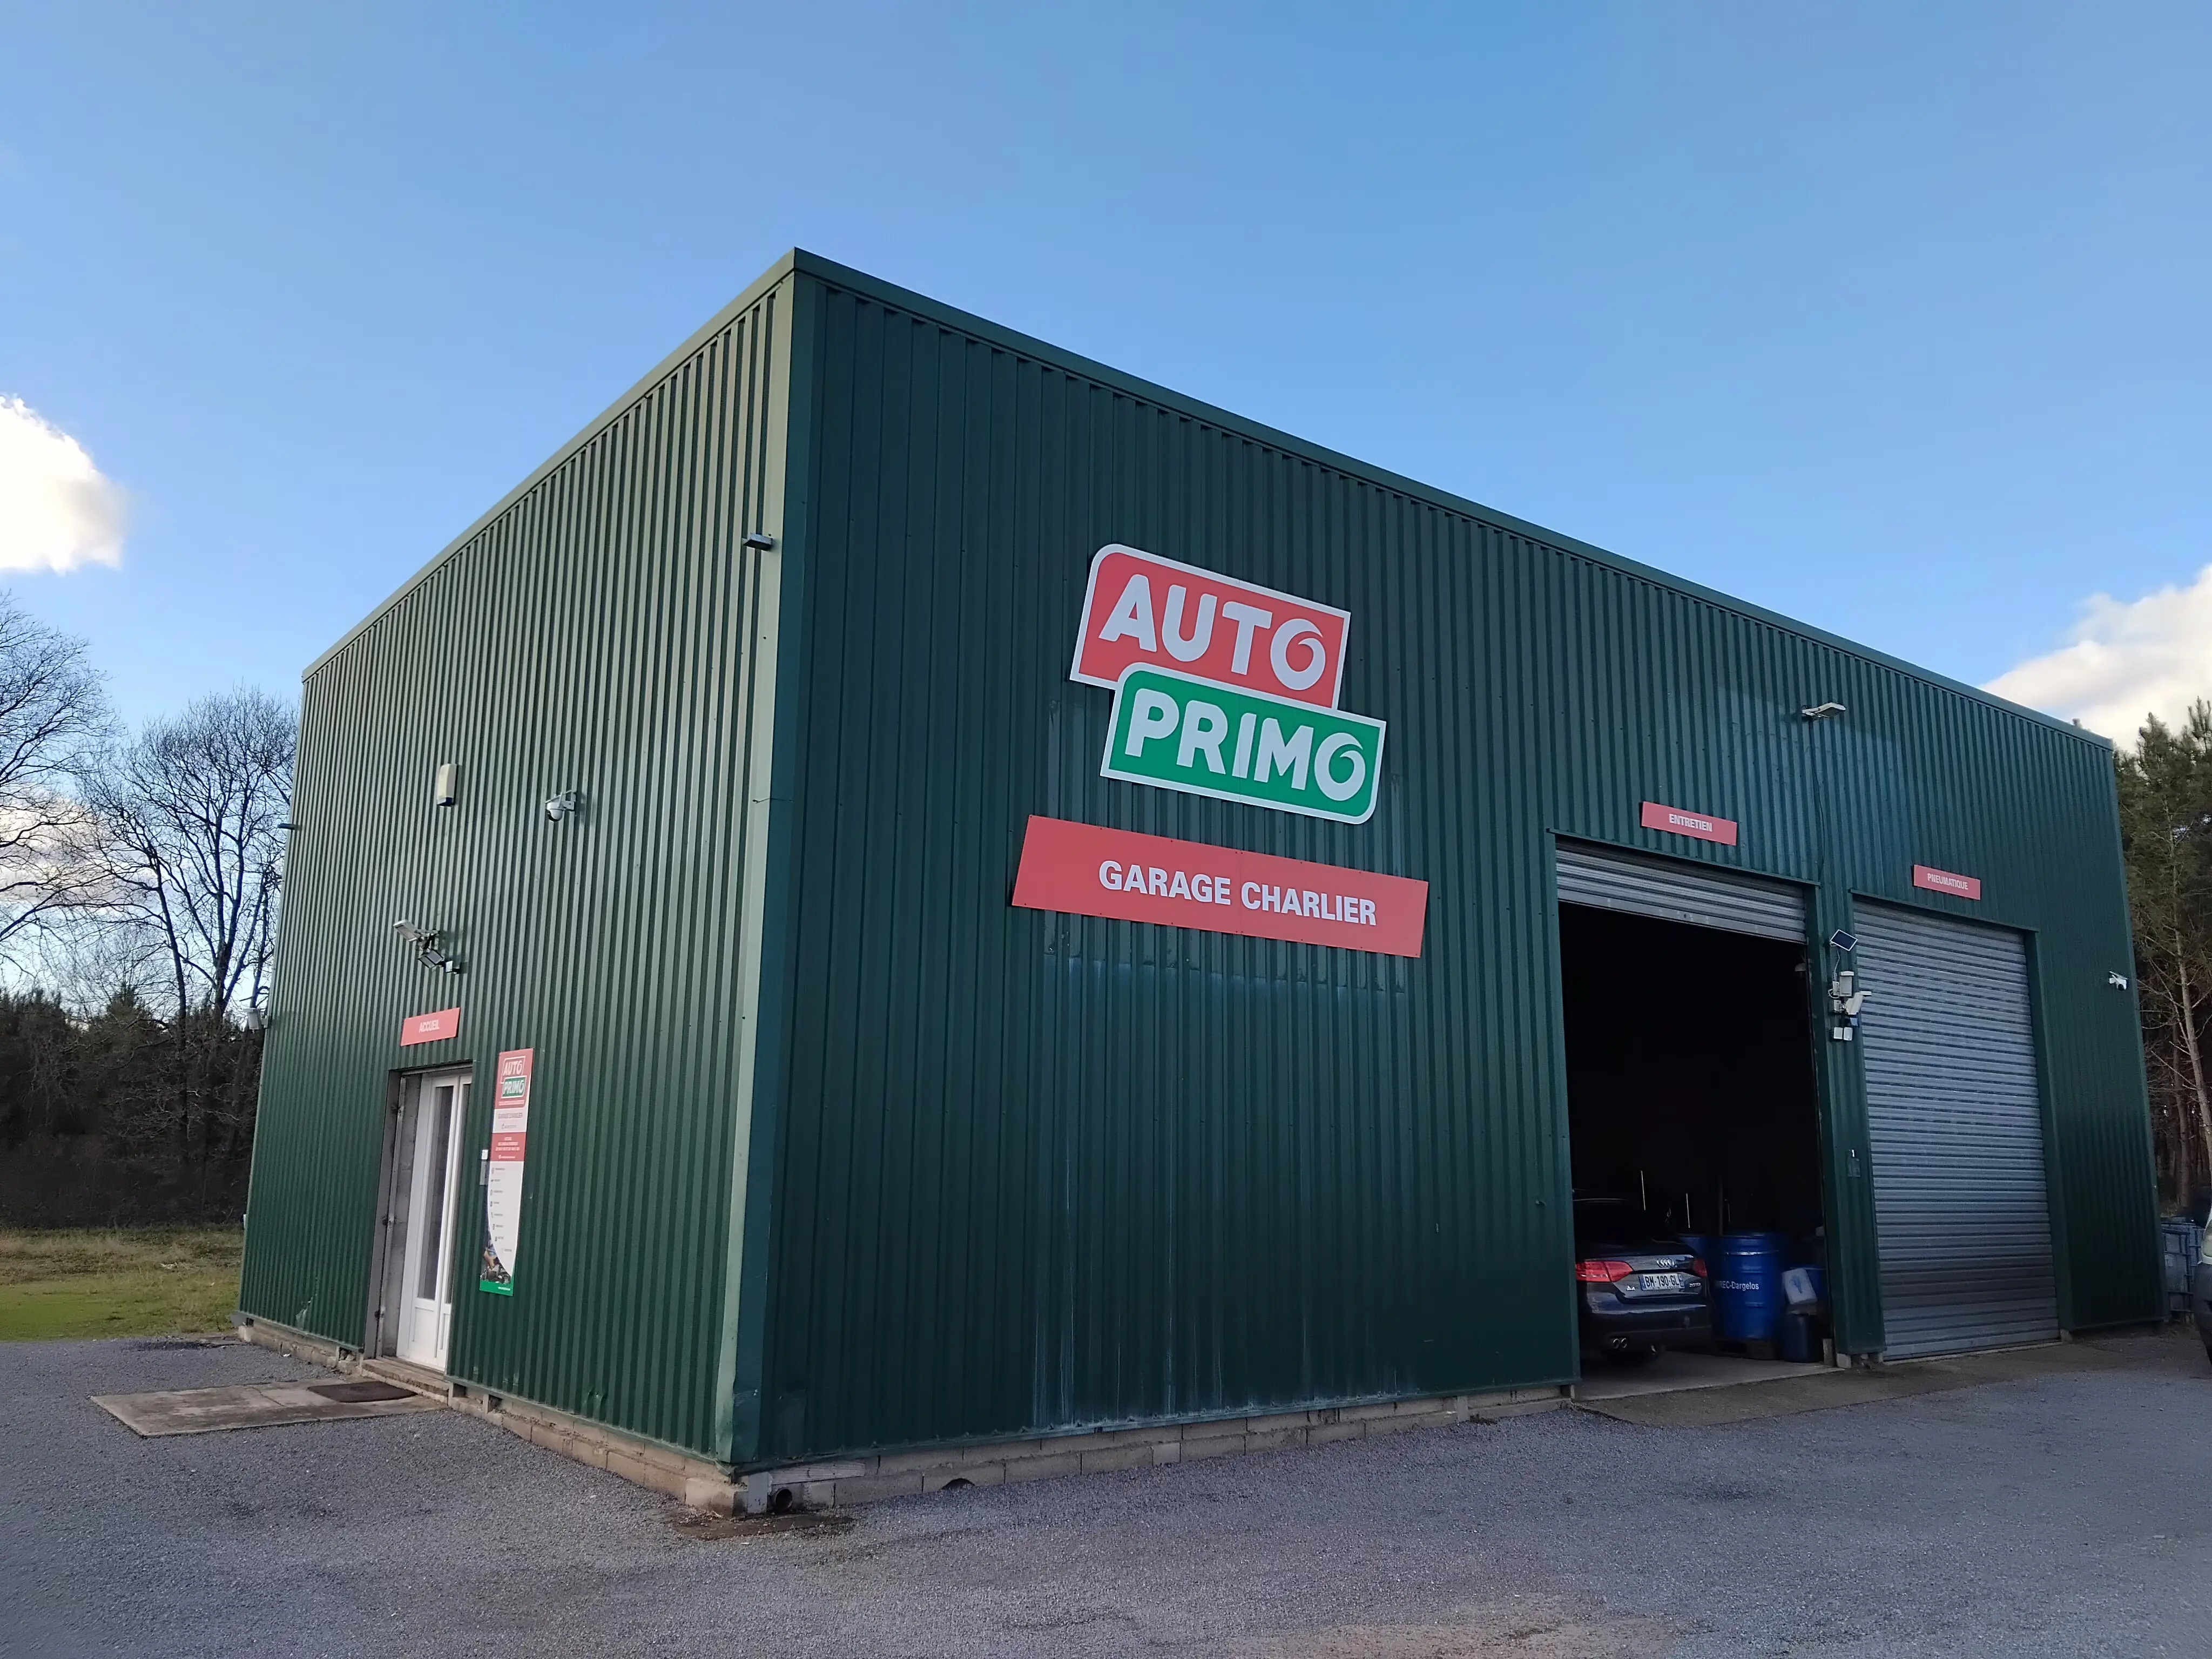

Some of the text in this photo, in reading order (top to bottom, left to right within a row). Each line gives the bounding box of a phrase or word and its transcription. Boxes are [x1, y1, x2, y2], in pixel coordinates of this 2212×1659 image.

[1098, 574, 1326, 690] AUTO
[1125, 688, 1366, 801] PRIMO
[1669, 813, 1712, 832] ENTRETIEN
[1927, 873, 1968, 890] PNEUMATIQUE
[1099, 860, 1376, 926] GARAGE CHARLIER
[419, 1019, 440, 1033] ACCUEIL
[503, 1060, 523, 1076] AUTO
[503, 1080, 524, 1094] PRIMO
